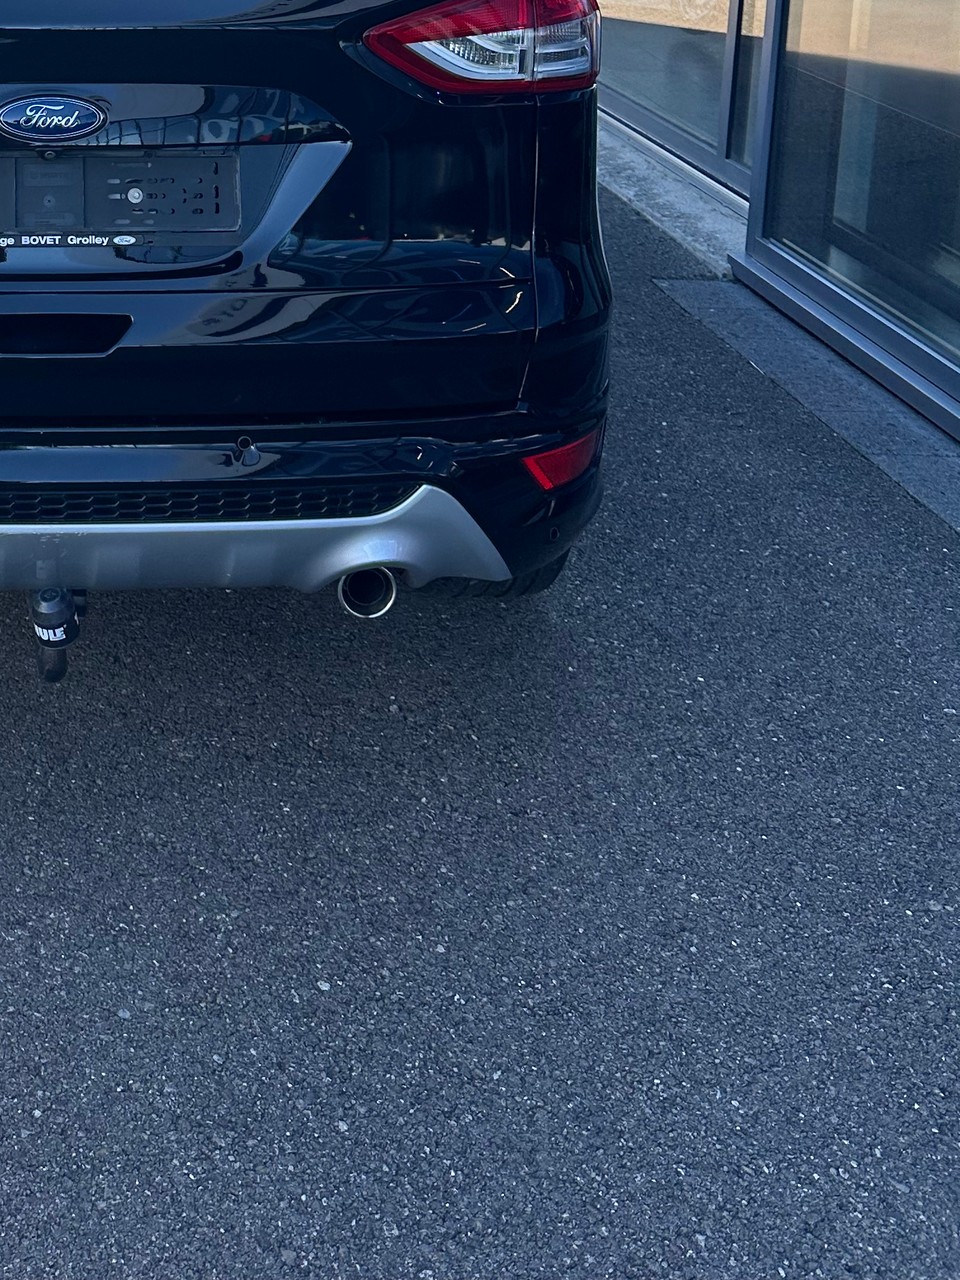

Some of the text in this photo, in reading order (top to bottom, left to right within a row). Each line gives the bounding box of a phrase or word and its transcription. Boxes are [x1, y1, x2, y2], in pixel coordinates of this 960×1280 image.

[20, 104, 81, 128] Ford
[21, 236, 62, 245] BOVET
[67, 235, 109, 246] Grolley
